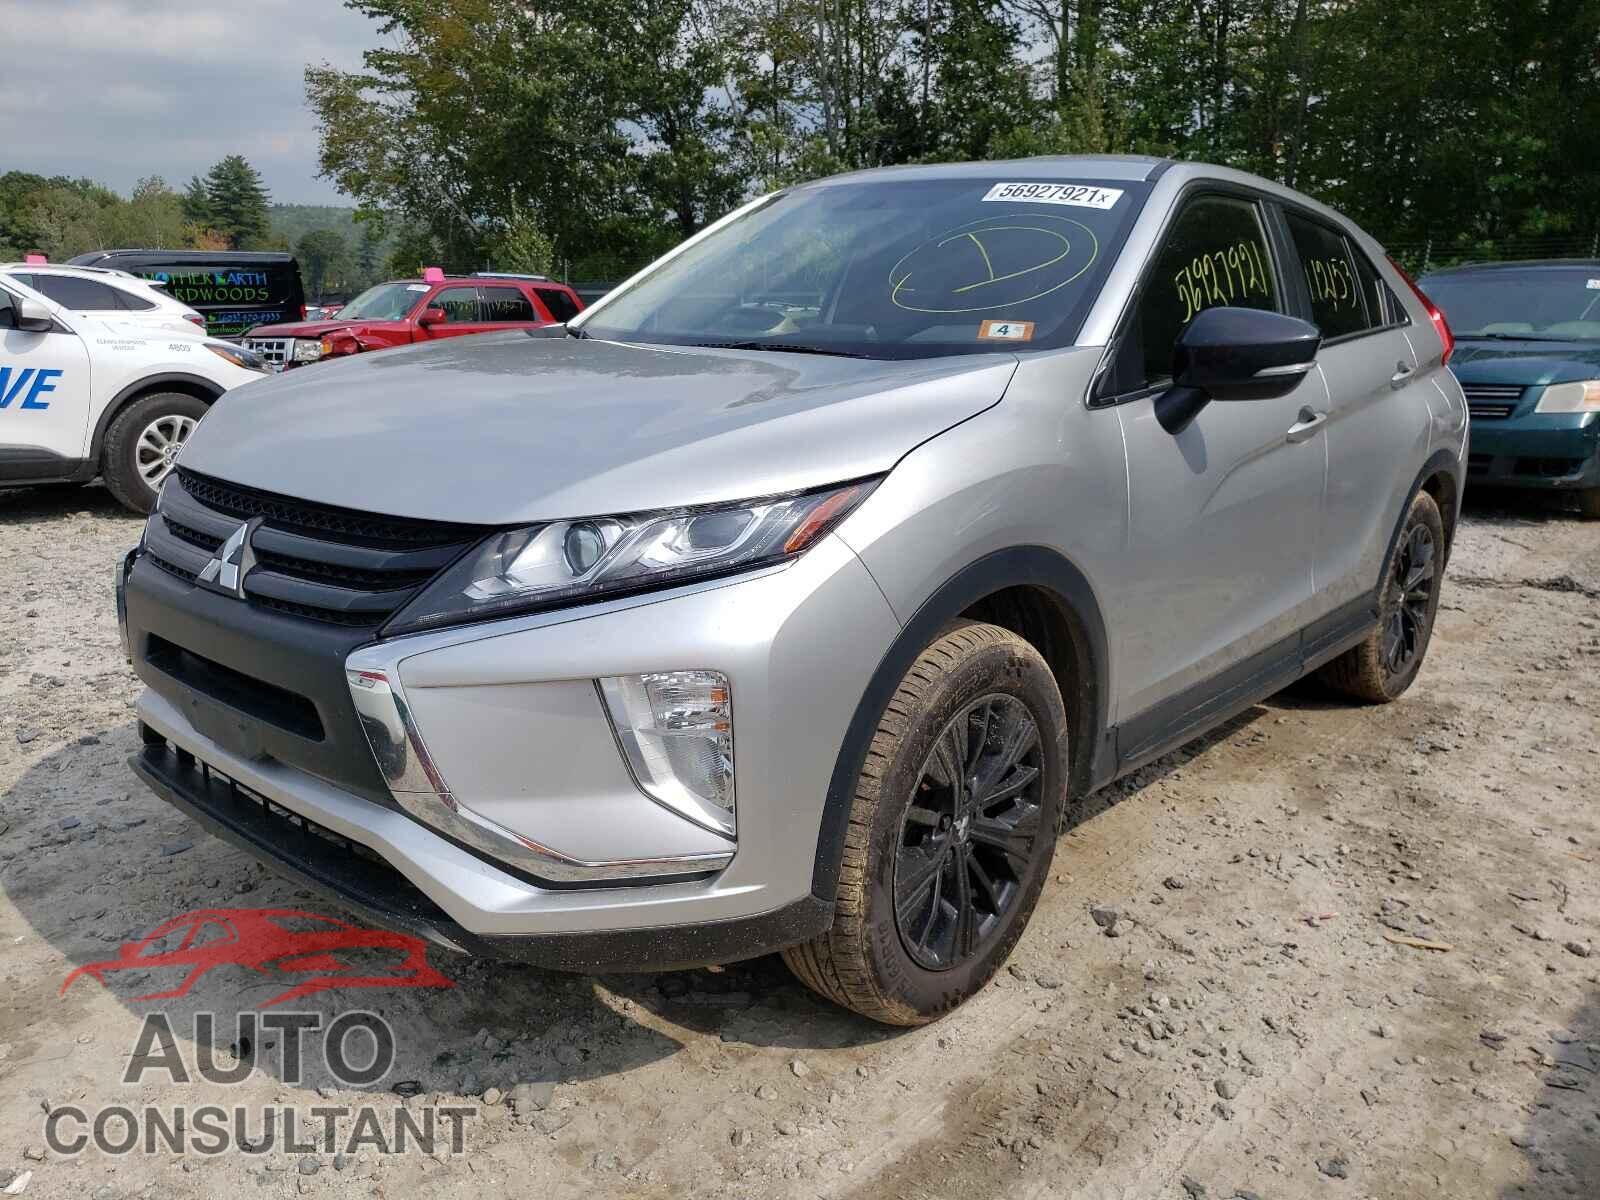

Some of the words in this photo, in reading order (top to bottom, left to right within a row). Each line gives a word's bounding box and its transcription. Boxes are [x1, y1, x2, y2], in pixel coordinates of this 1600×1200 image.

[214, 271, 268, 286] EARTH
[1174, 240, 1268, 323] 56927921
[996, 325, 1009, 335] 4
